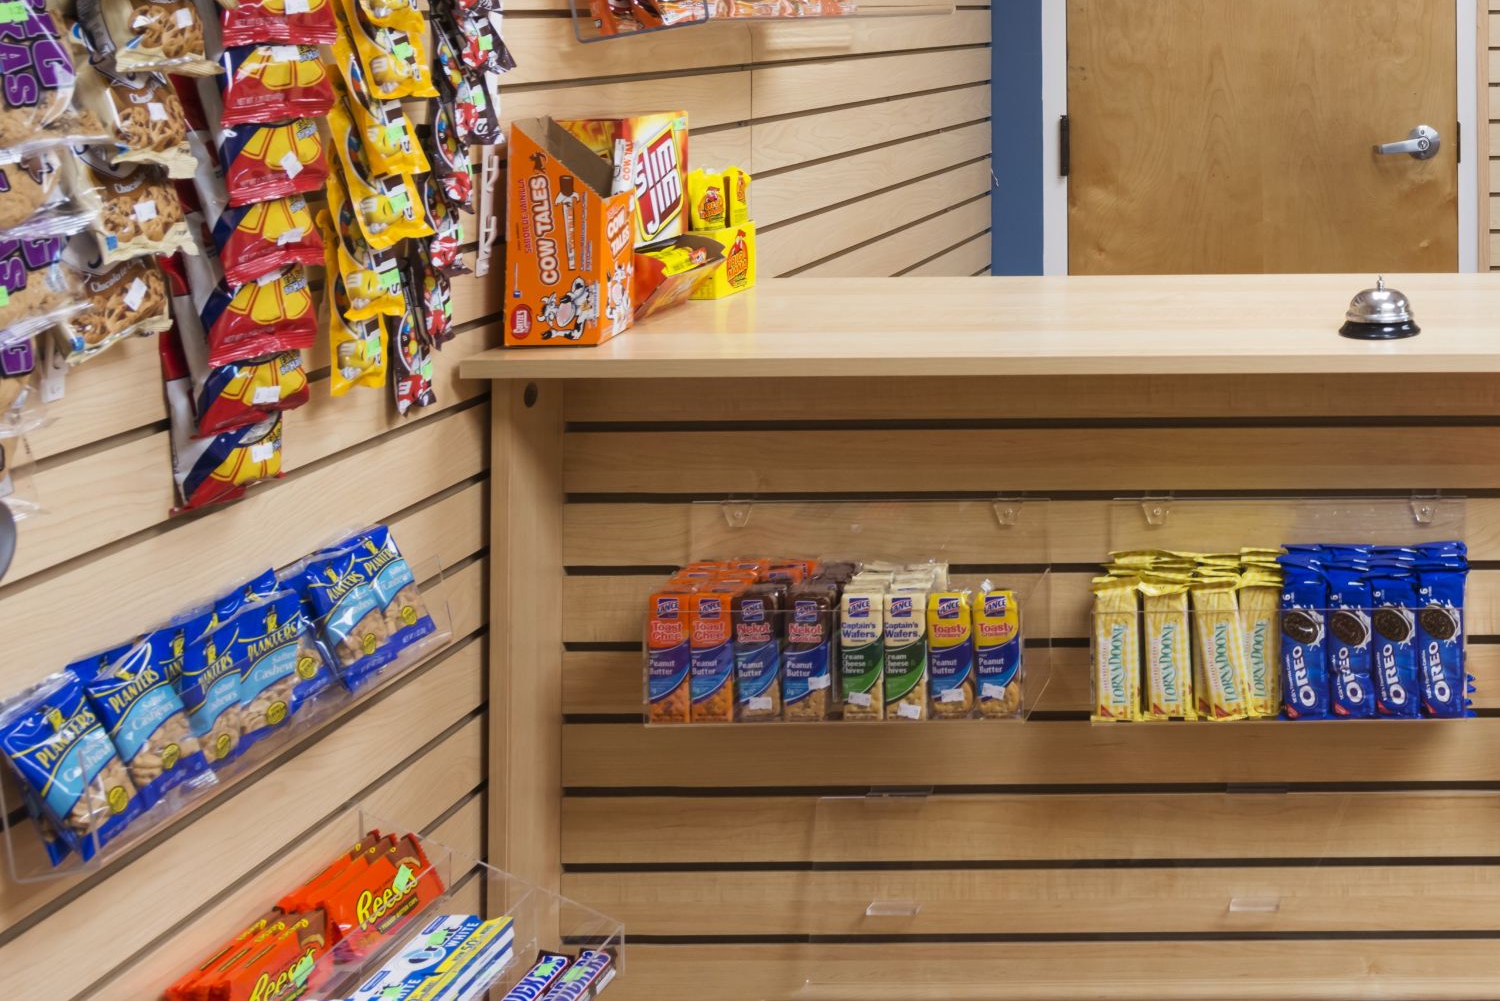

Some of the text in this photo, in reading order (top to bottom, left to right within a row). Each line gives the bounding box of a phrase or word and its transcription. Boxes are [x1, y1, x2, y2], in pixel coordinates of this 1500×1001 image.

[607, 210, 625, 237] COW
[528, 174, 560, 286] COW TALES
[611, 224, 631, 257] TALES
[652, 621, 683, 632] Toast
[694, 621, 725, 632] Toast
[788, 623, 823, 634] Nekot
[841, 622, 876, 630] Captain's
[884, 622, 919, 630] Captain's
[933, 623, 967, 635] Toasty
[978, 622, 1013, 634] Toasty
[247, 621, 298, 661] PLANTERS
[652, 631, 683, 641] Chee
[694, 631, 725, 641] Chee
[737, 661, 764, 669] Peanut
[787, 661, 812, 669] Peanut
[932, 658, 957, 667] Peanut
[978, 657, 1005, 666] Peanut
[254, 660, 295, 682] Cashew
[932, 666, 956, 675] Butter
[978, 666, 1003, 674] Butter
[1292, 645, 1316, 707] OREO
[1339, 647, 1363, 703] OREO
[1383, 643, 1407, 705] OREO
[1428, 641, 1451, 703] OREO
[108, 666, 160, 714] PLANTERS
[35, 706, 96, 769] PLANTERS
[445, 922, 480, 948] WHITE
